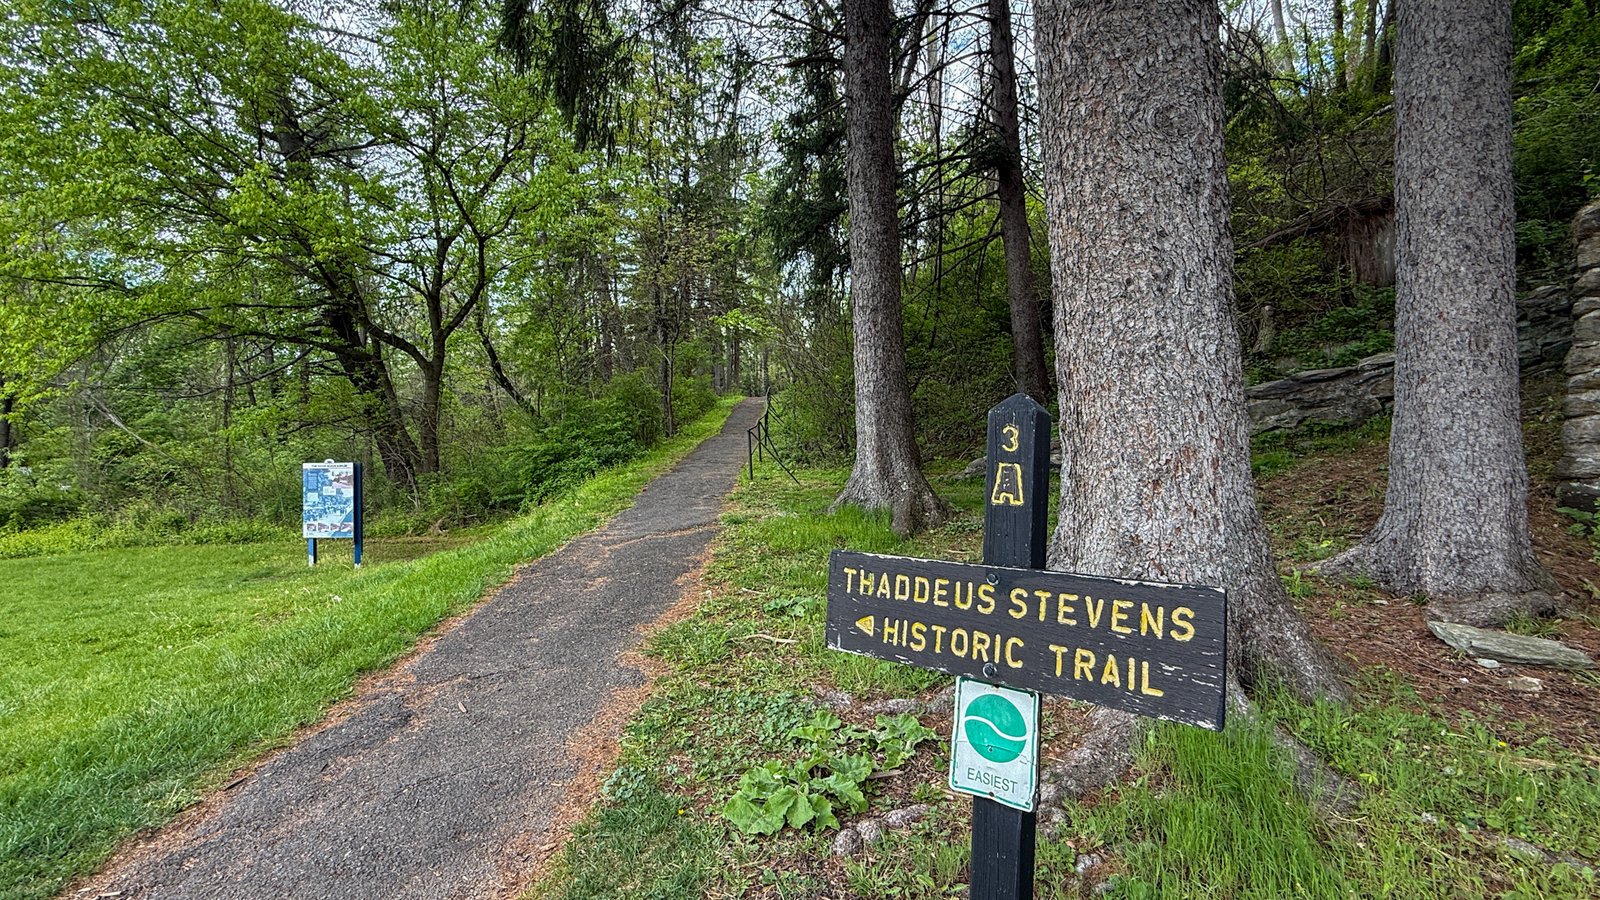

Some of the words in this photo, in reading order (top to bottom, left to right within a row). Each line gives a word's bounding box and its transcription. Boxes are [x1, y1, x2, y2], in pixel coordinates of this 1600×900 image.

[1002, 425, 1019, 452] 3
[843, 567, 996, 615] THADDEUS
[1008, 587, 1196, 642] STEVENS
[882, 617, 1025, 669] HISTORIC
[1048, 644, 1165, 697] TRAIL
[967, 767, 1018, 794] EASIEST
